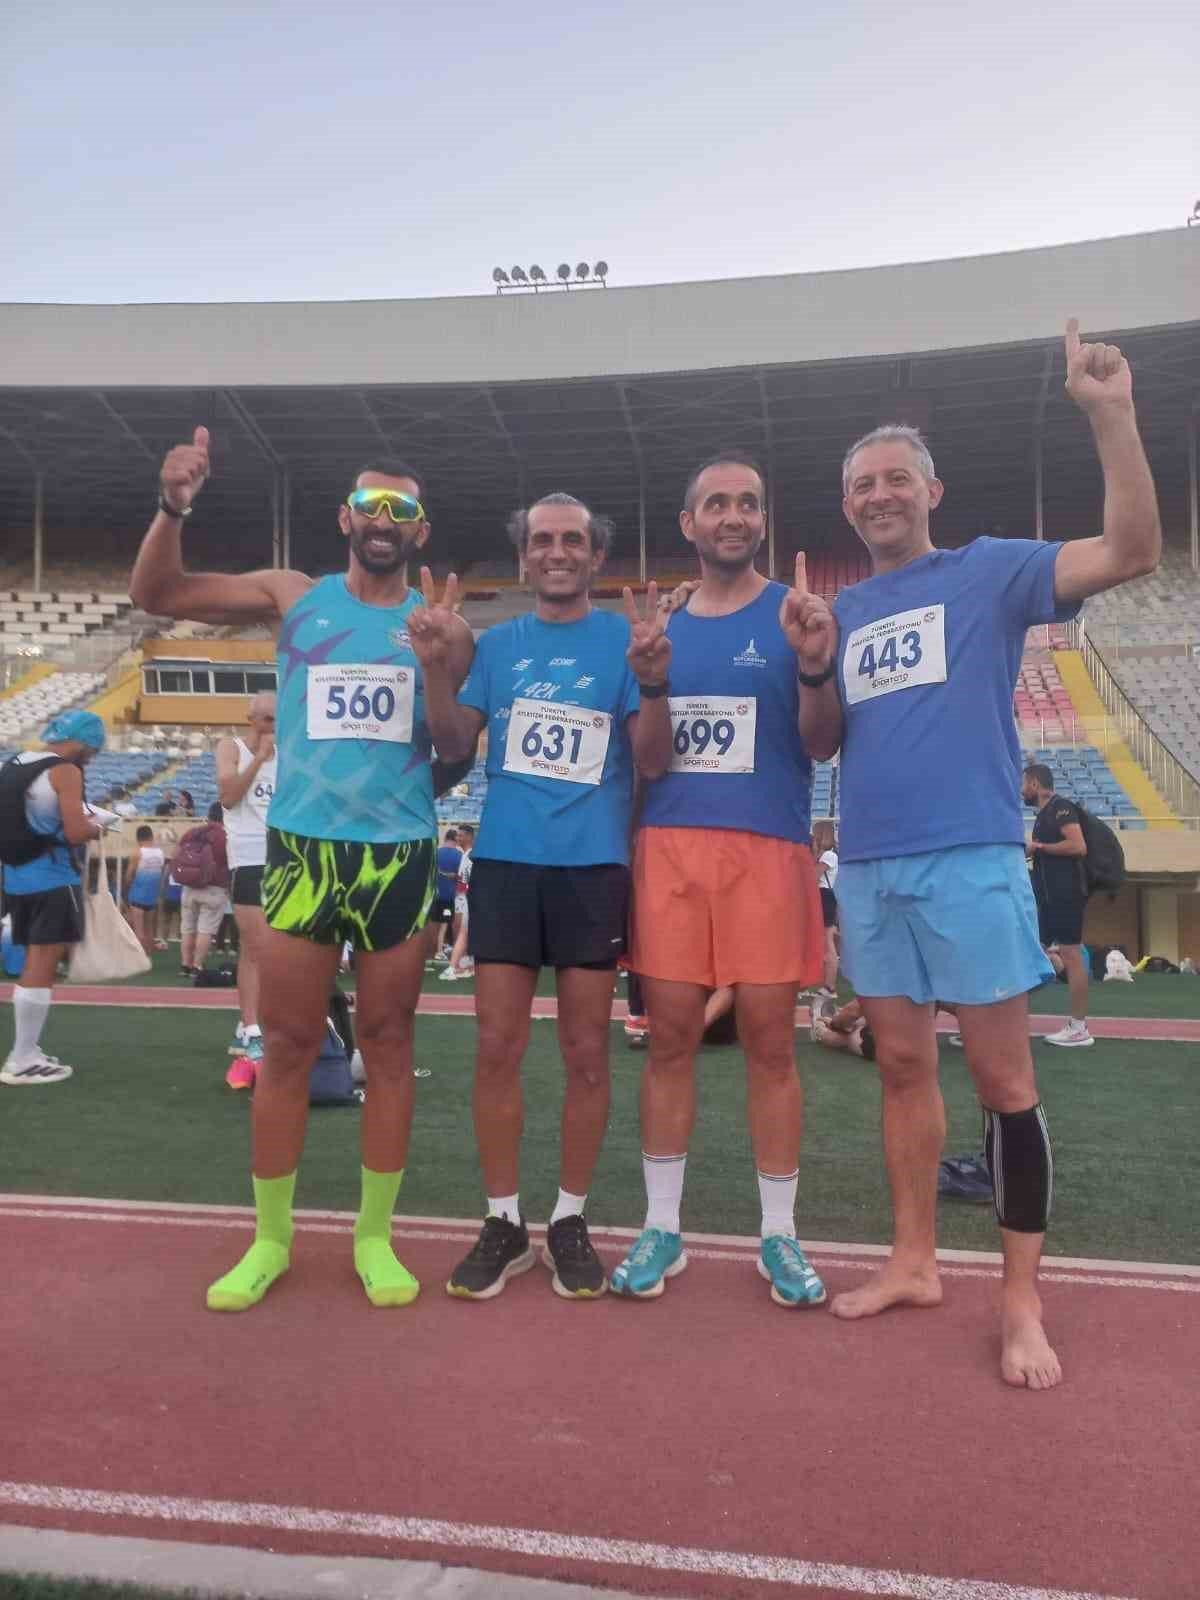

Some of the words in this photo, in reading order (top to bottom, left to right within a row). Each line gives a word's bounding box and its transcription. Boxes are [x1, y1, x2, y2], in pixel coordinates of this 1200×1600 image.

[858, 631, 922, 679] 443
[326, 684, 395, 722] 560
[523, 681, 561, 699] 42K
[521, 721, 583, 764] 631
[673, 719, 735, 755] 699
